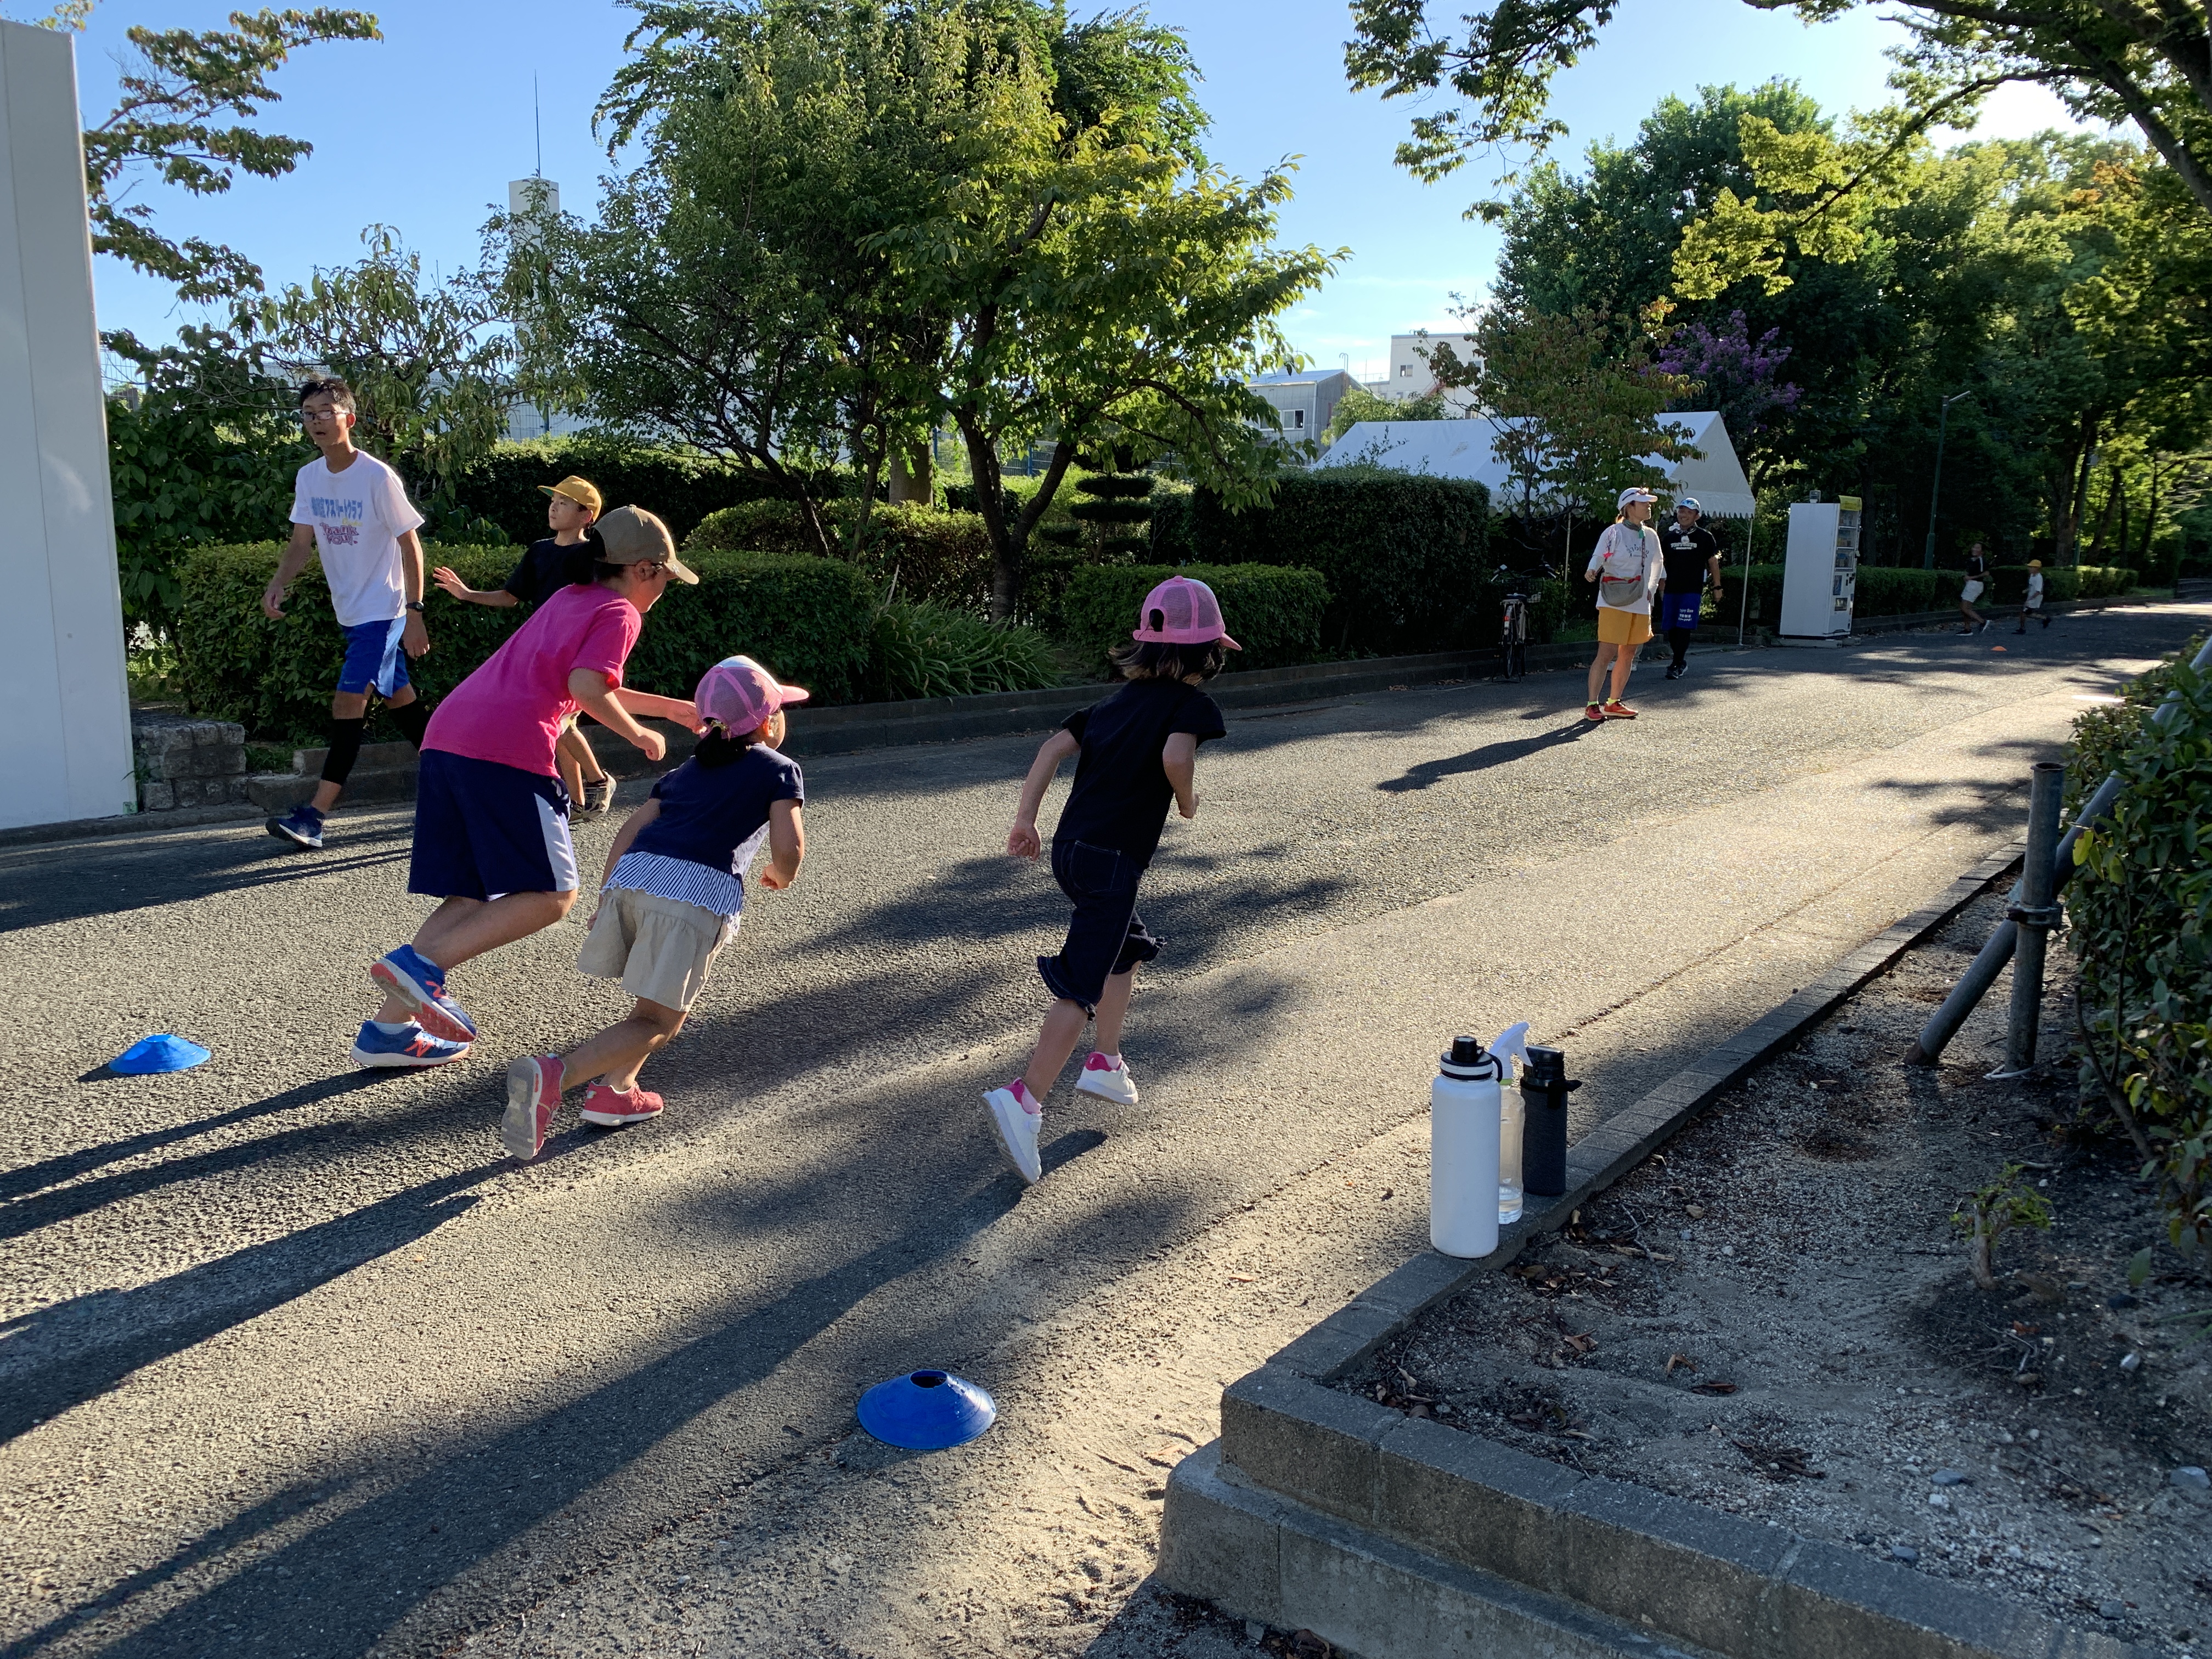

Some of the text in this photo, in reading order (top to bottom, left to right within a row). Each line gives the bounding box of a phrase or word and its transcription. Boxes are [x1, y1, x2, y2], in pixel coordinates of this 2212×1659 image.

[311, 496, 363, 520] アスリートクラブ
